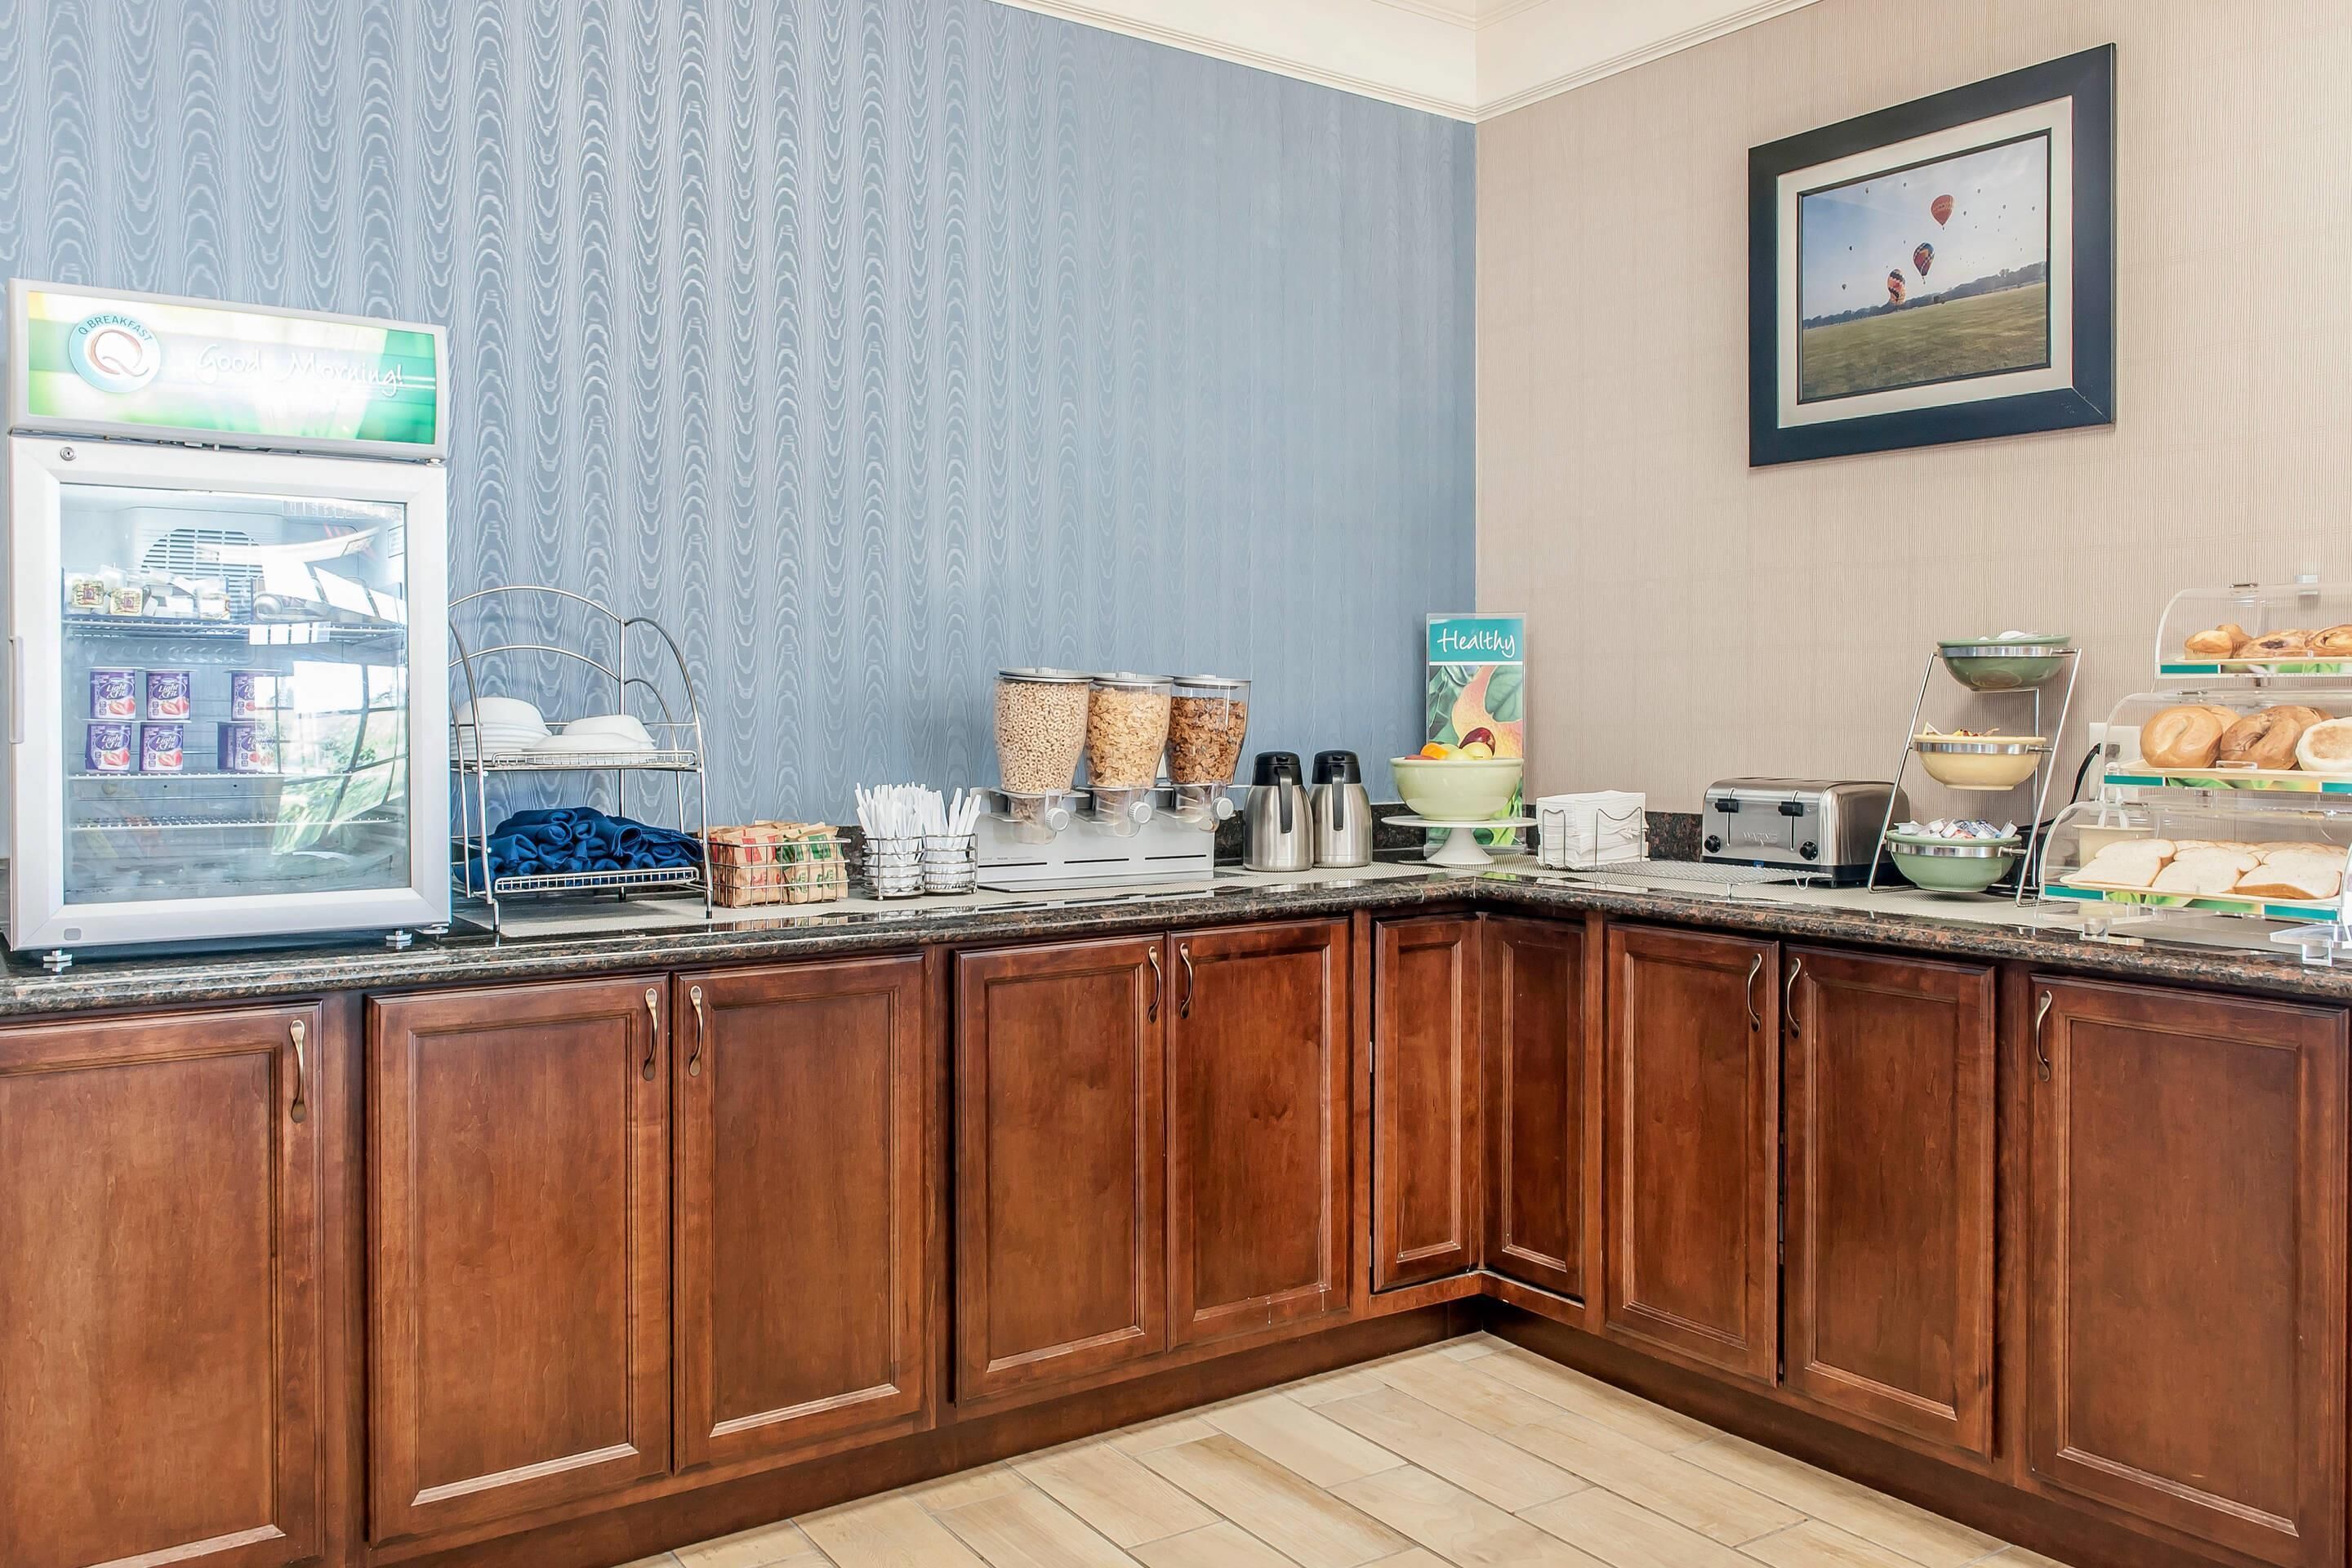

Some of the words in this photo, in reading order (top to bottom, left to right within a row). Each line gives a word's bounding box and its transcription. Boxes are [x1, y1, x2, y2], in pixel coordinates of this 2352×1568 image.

[78, 327, 88, 335] Q
[87, 315, 153, 341] BREAKFAST
[196, 343, 261, 384] Good
[275, 351, 404, 397] Morning!
[1437, 627, 1515, 658] Healthy
[106, 683, 126, 693] Light
[158, 683, 178, 693] Light
[102, 734, 121, 744] Light
[156, 735, 176, 745] Light
